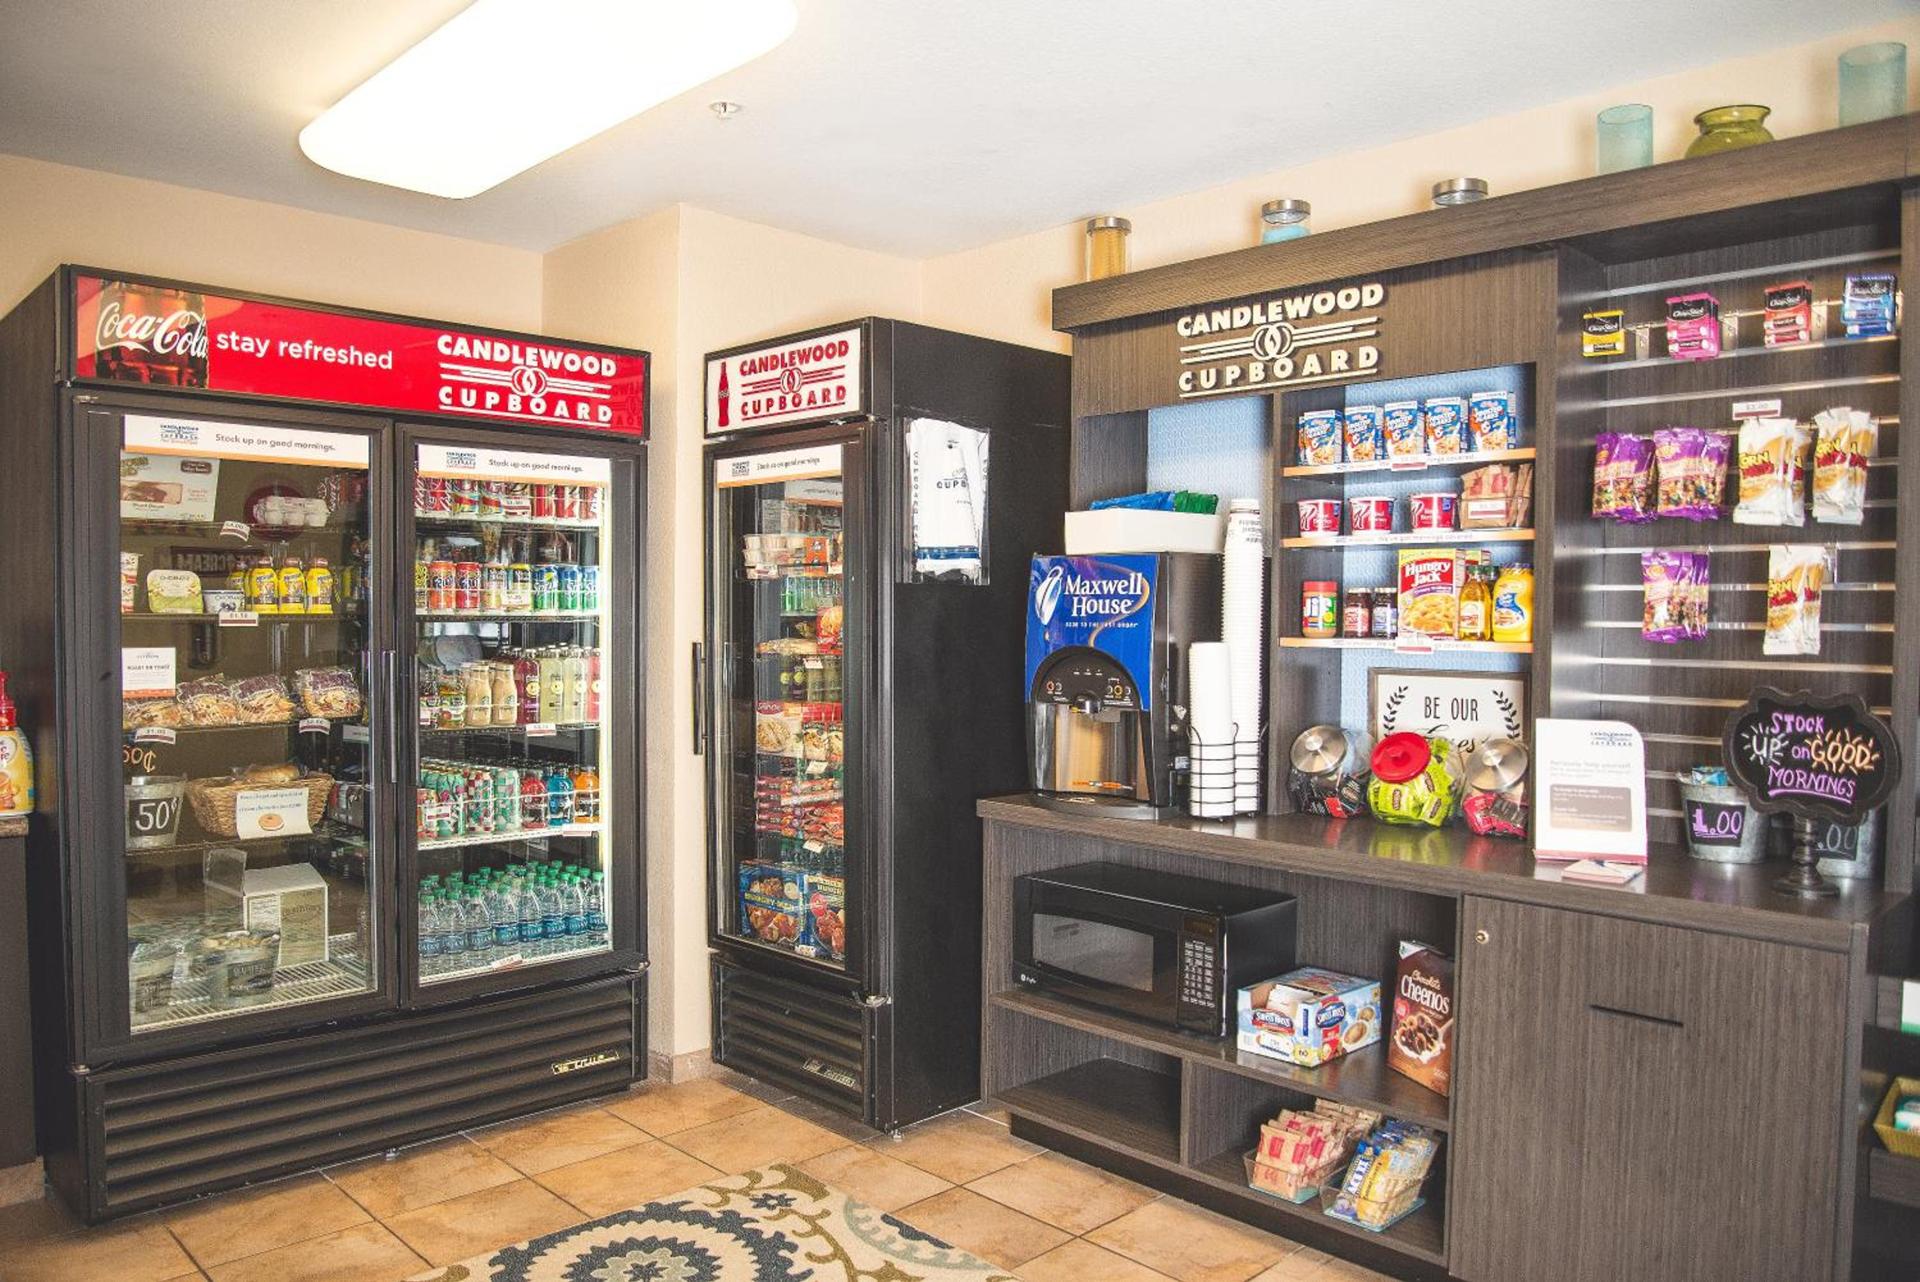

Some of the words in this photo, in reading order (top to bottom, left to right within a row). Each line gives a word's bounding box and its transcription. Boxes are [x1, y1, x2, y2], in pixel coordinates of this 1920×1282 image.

[1177, 283, 1384, 337] CANDLEWOOD
[96, 302, 207, 358] Coca-Cola
[216, 331, 269, 358] stay
[278, 339, 393, 371] refreshed
[437, 335, 617, 377] CANDLEWOOD
[739, 340, 849, 377] CANDLEWOOD
[1178, 345, 1379, 392] CUPBOARD
[438, 385, 613, 423] CUPBOARD
[741, 385, 847, 416] CUPBOARD
[215, 433, 240, 443] Stock
[242, 437, 254, 446] up
[269, 440, 293, 448] good
[1064, 572, 1143, 595] Maxwell
[1404, 559, 1451, 578] Hungry
[1411, 571, 1441, 588] Jack
[1071, 596, 1132, 617] House
[1424, 696, 1441, 719] BE
[1451, 697, 1479, 721] OUR
[1771, 712, 1824, 734] STOCK
[1752, 736, 1782, 759] UP
[1792, 745, 1811, 759] on
[1810, 739, 1871, 768] GOOD
[1767, 766, 1856, 798] MORNINGS
[1817, 823, 1859, 851] .00
[1400, 974, 1450, 1015] Cheerios
